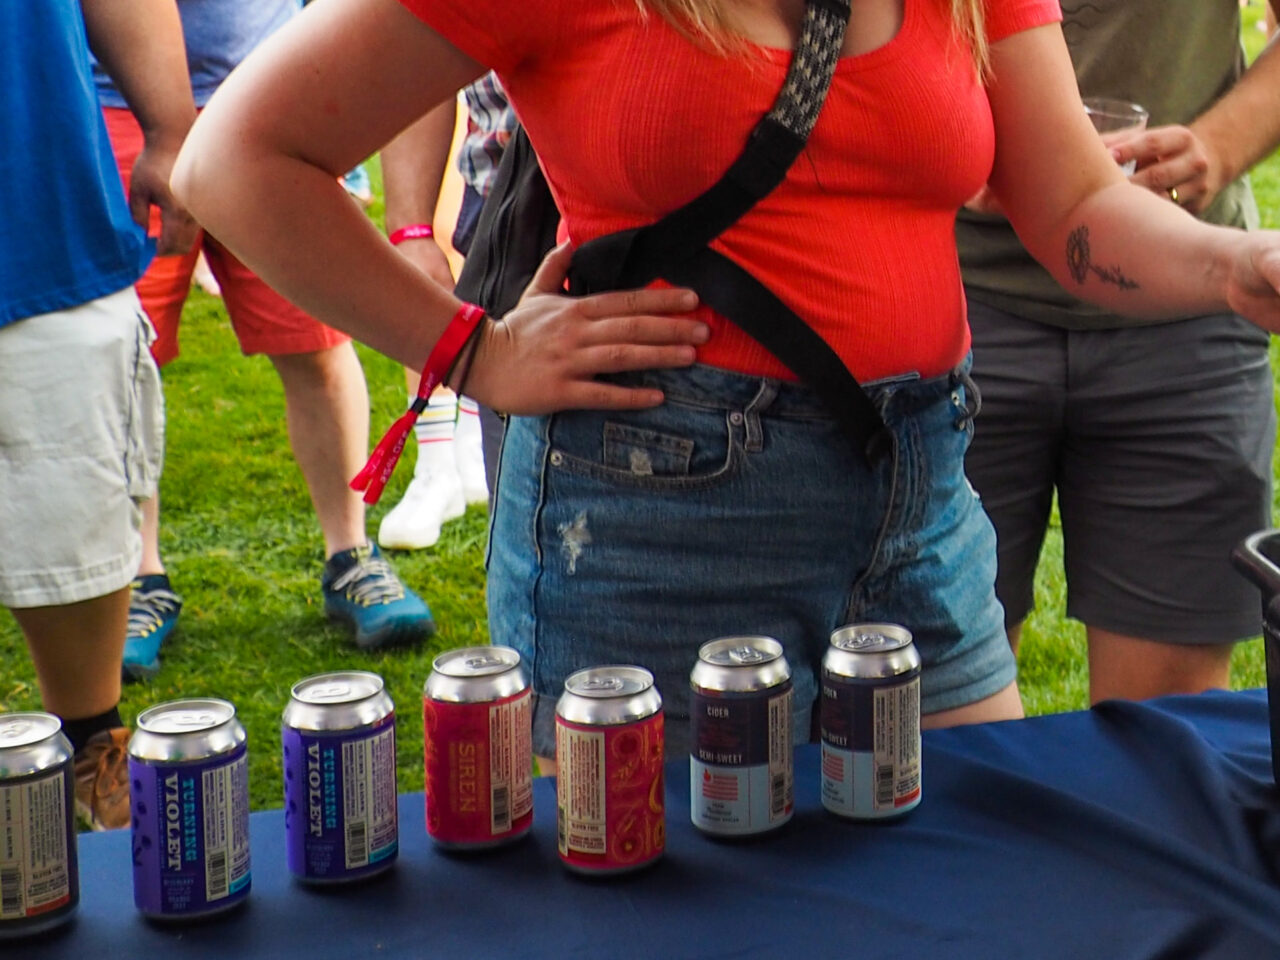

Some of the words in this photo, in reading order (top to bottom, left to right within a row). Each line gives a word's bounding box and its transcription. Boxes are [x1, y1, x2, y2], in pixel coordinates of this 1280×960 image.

[706, 704, 730, 719] CIDER
[308, 742, 323, 837] VIOLET
[323, 749, 337, 829] TURNING
[459, 743, 476, 812] SIREN
[699, 749, 743, 764] SEMI-SWEET
[165, 772, 182, 871] VIOLET
[182, 778, 198, 862] TURNING
